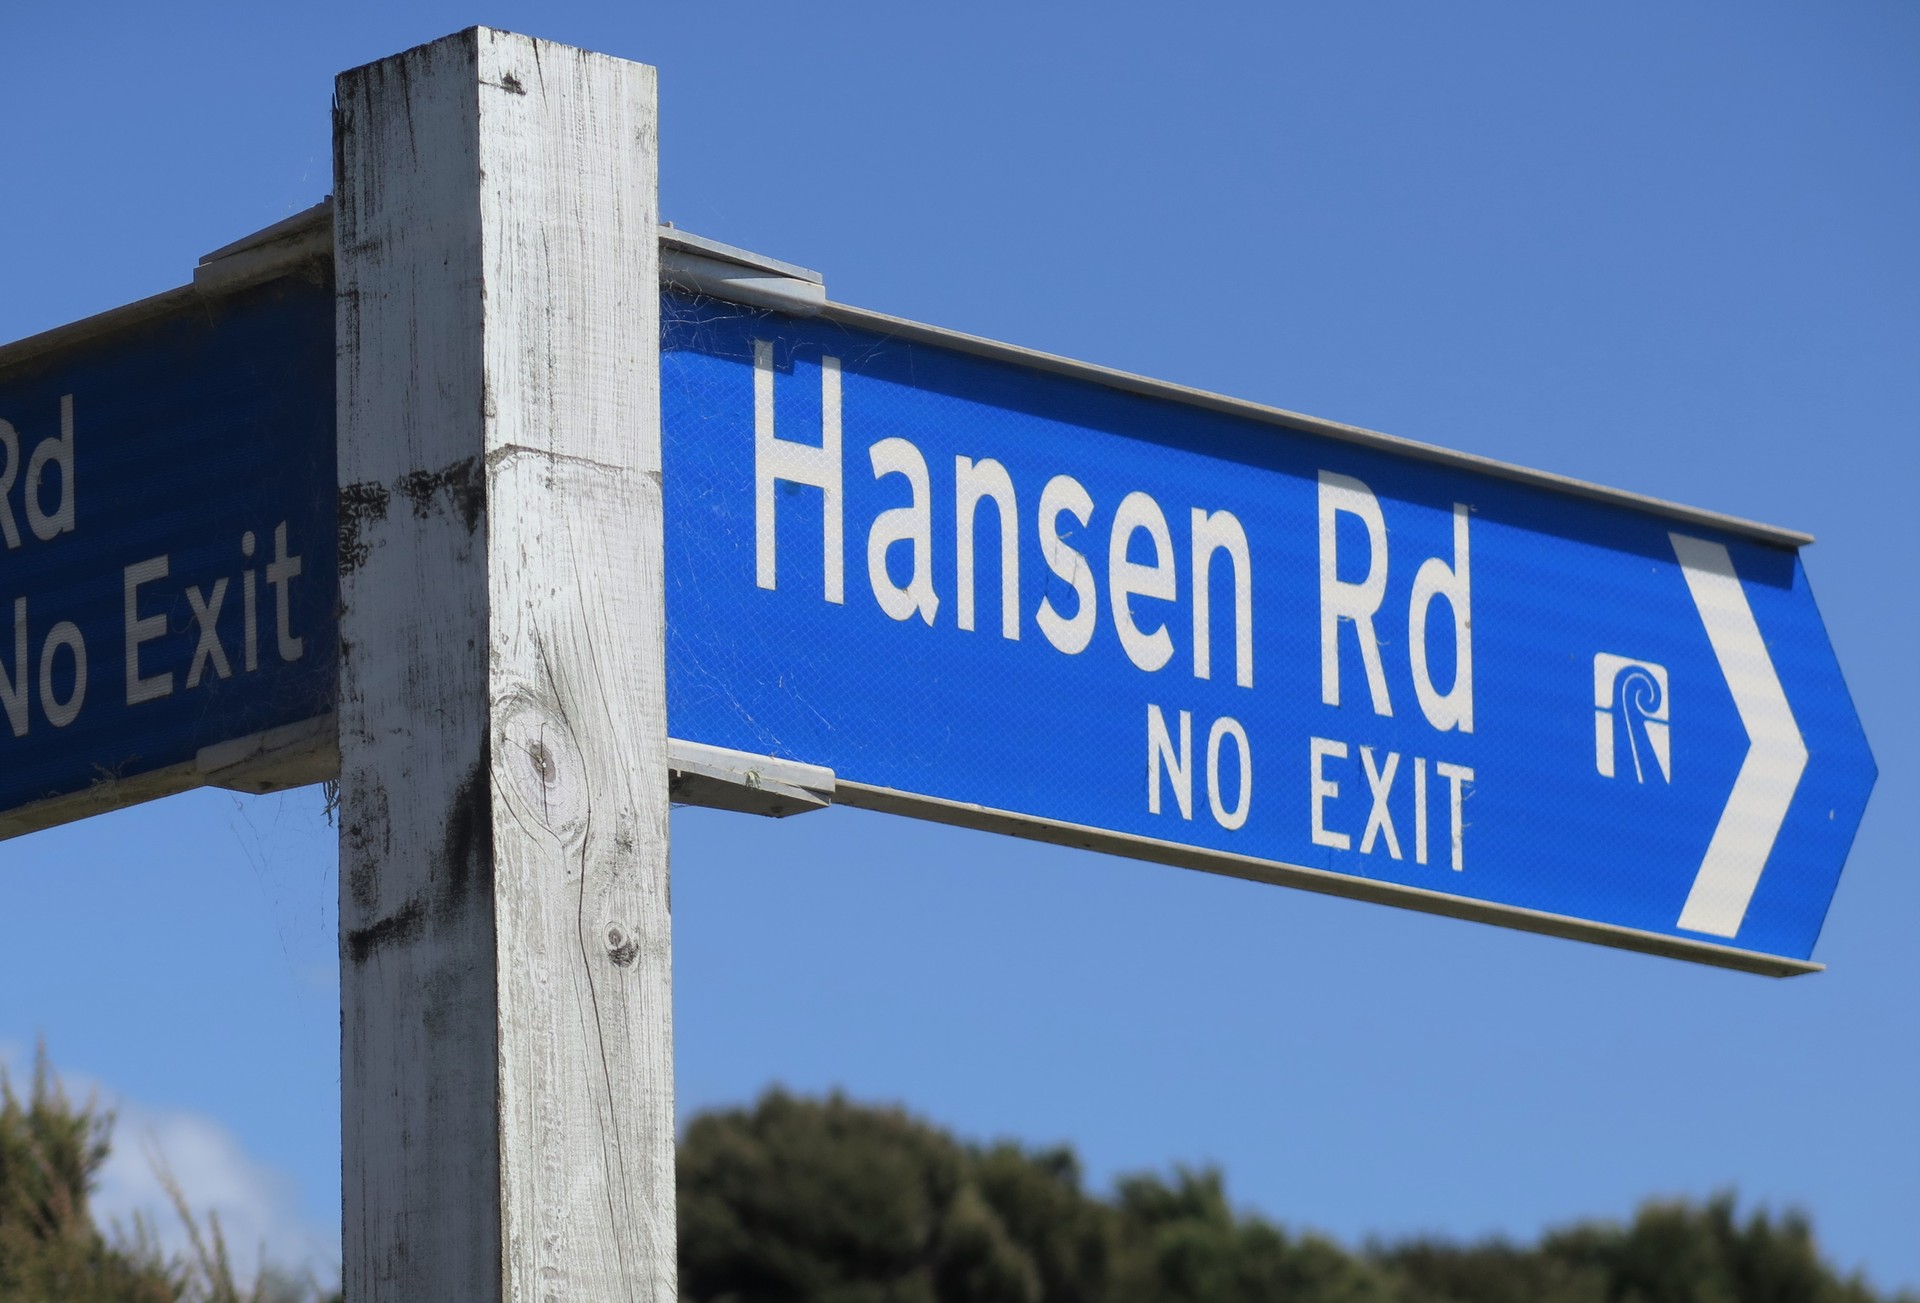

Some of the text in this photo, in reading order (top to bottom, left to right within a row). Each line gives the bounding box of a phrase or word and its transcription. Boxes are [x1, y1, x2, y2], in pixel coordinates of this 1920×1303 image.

[124, 520, 303, 706] Exit
[754, 341, 1474, 734] Hansen Rd
[1148, 704, 1475, 872] NO EXIT
